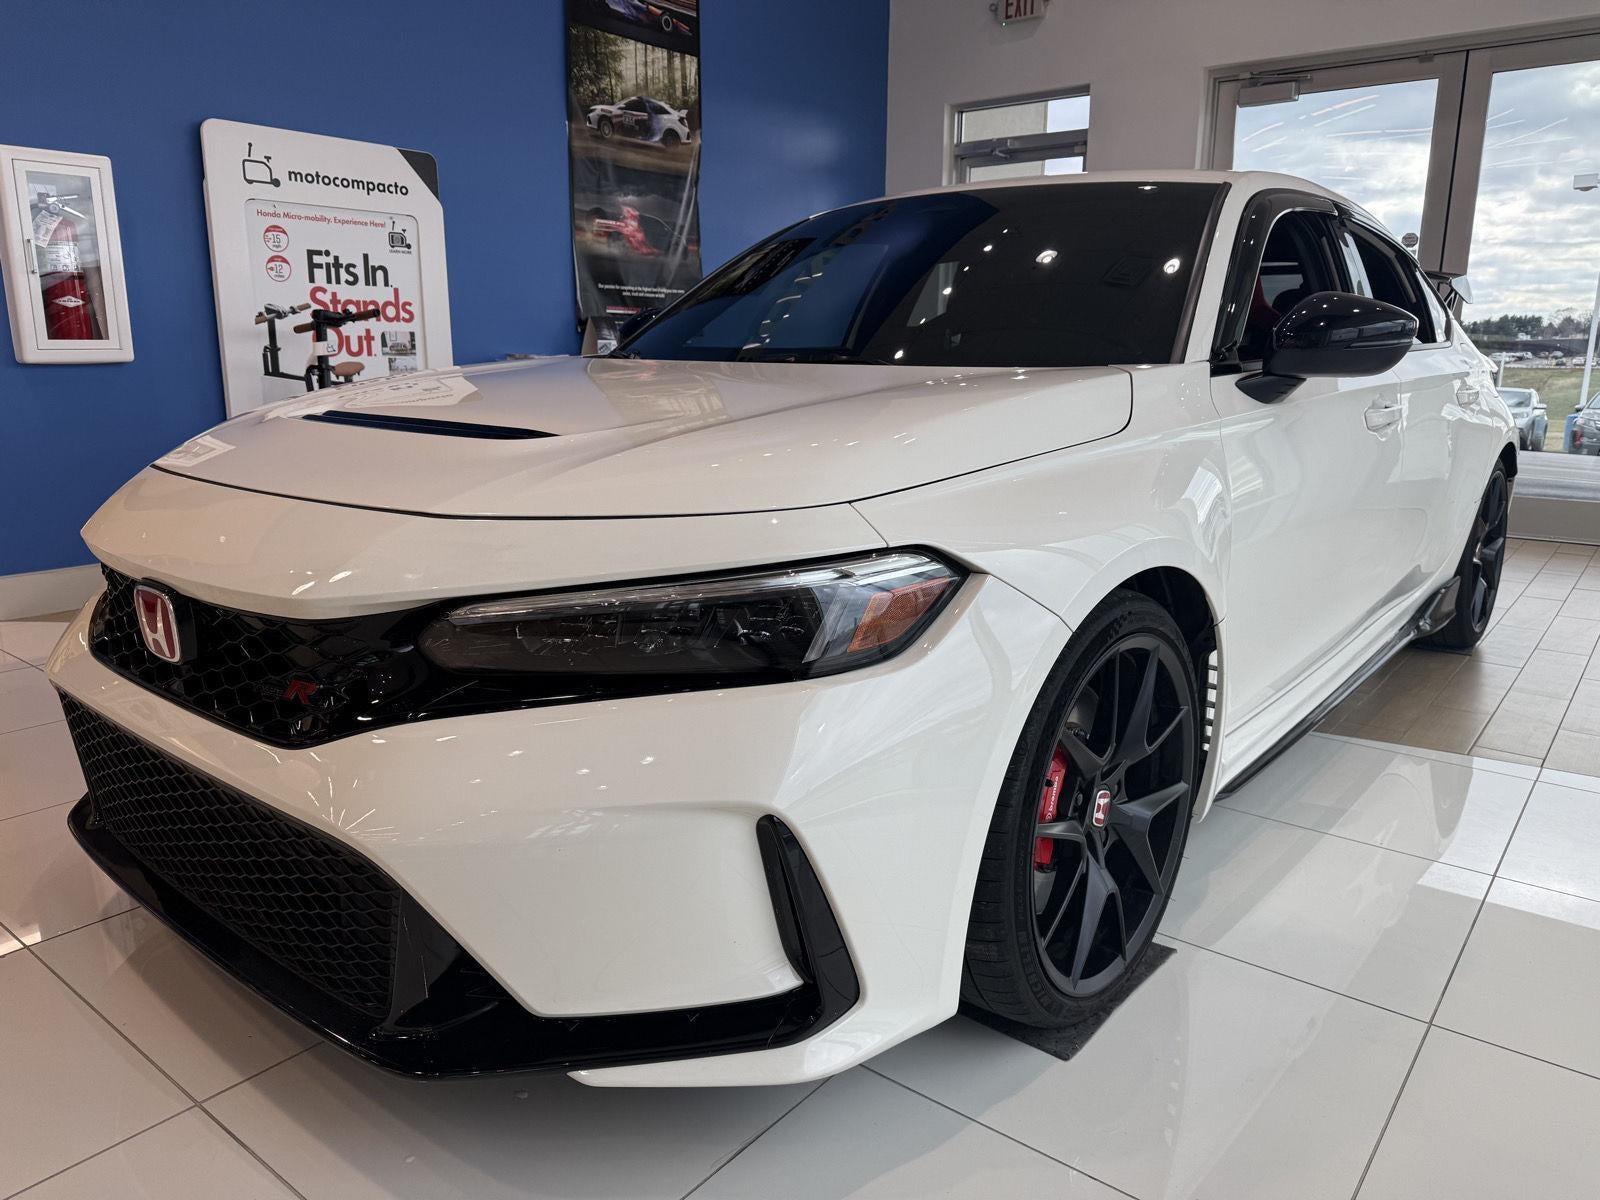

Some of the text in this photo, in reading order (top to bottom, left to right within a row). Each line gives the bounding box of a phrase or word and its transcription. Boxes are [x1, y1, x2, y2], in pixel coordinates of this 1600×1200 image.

[288, 168, 409, 196] motocompacto
[256, 209, 281, 219] Honda
[334, 217, 368, 227] Experience
[369, 219, 386, 228] Here!
[272, 234, 281, 243] 15
[274, 263, 283, 273] 12
[306, 249, 359, 286] Fits
[309, 286, 415, 323] Stands
[281, 679, 320, 705] R
[1048, 776, 1059, 812] brembo
